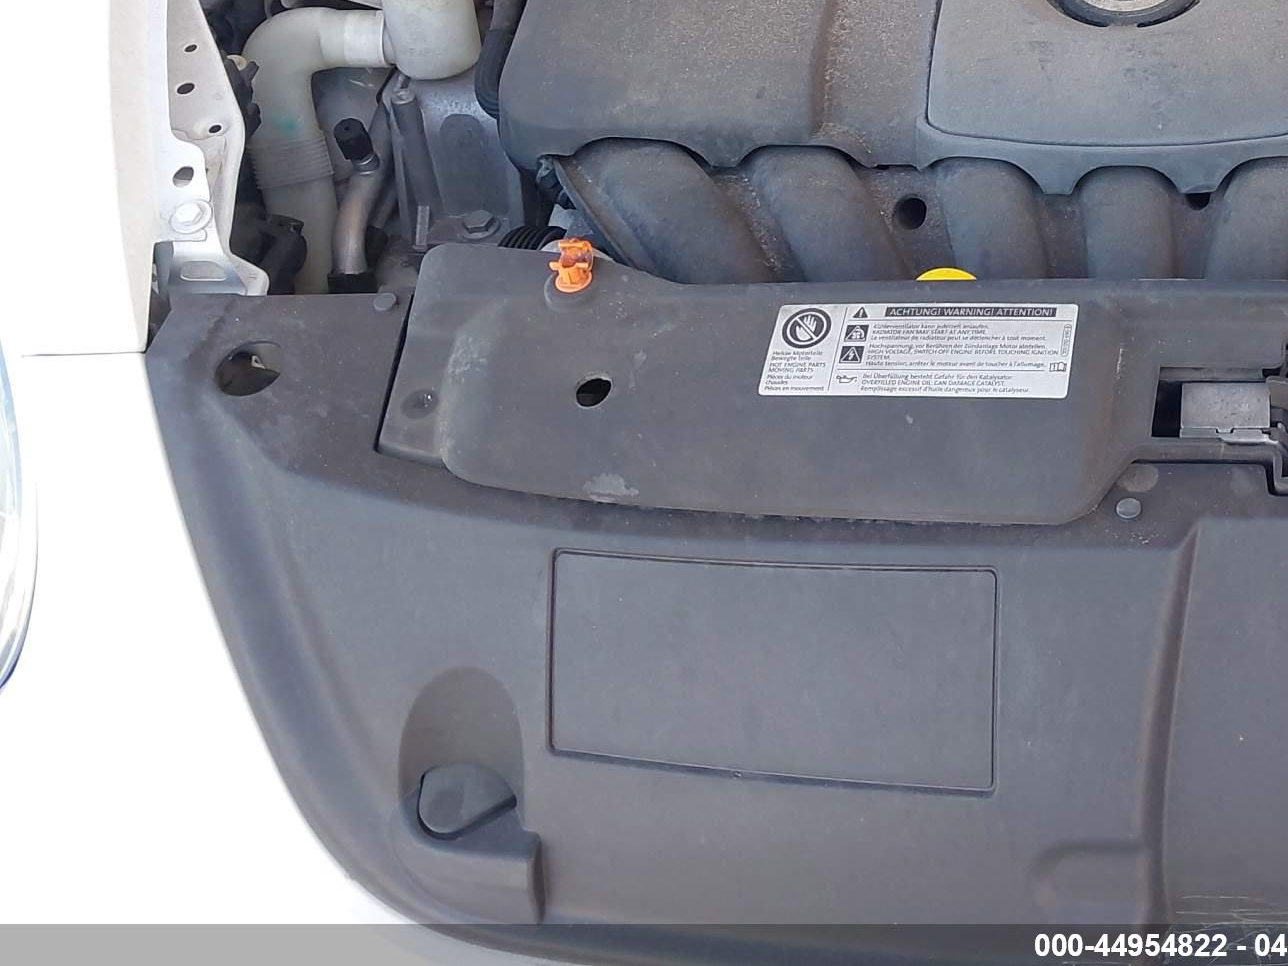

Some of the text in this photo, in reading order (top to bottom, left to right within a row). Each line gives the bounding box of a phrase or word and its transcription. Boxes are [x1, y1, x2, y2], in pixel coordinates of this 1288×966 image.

[888, 307, 1054, 317] ACHTUNG! WARNING! ATTENTION!
